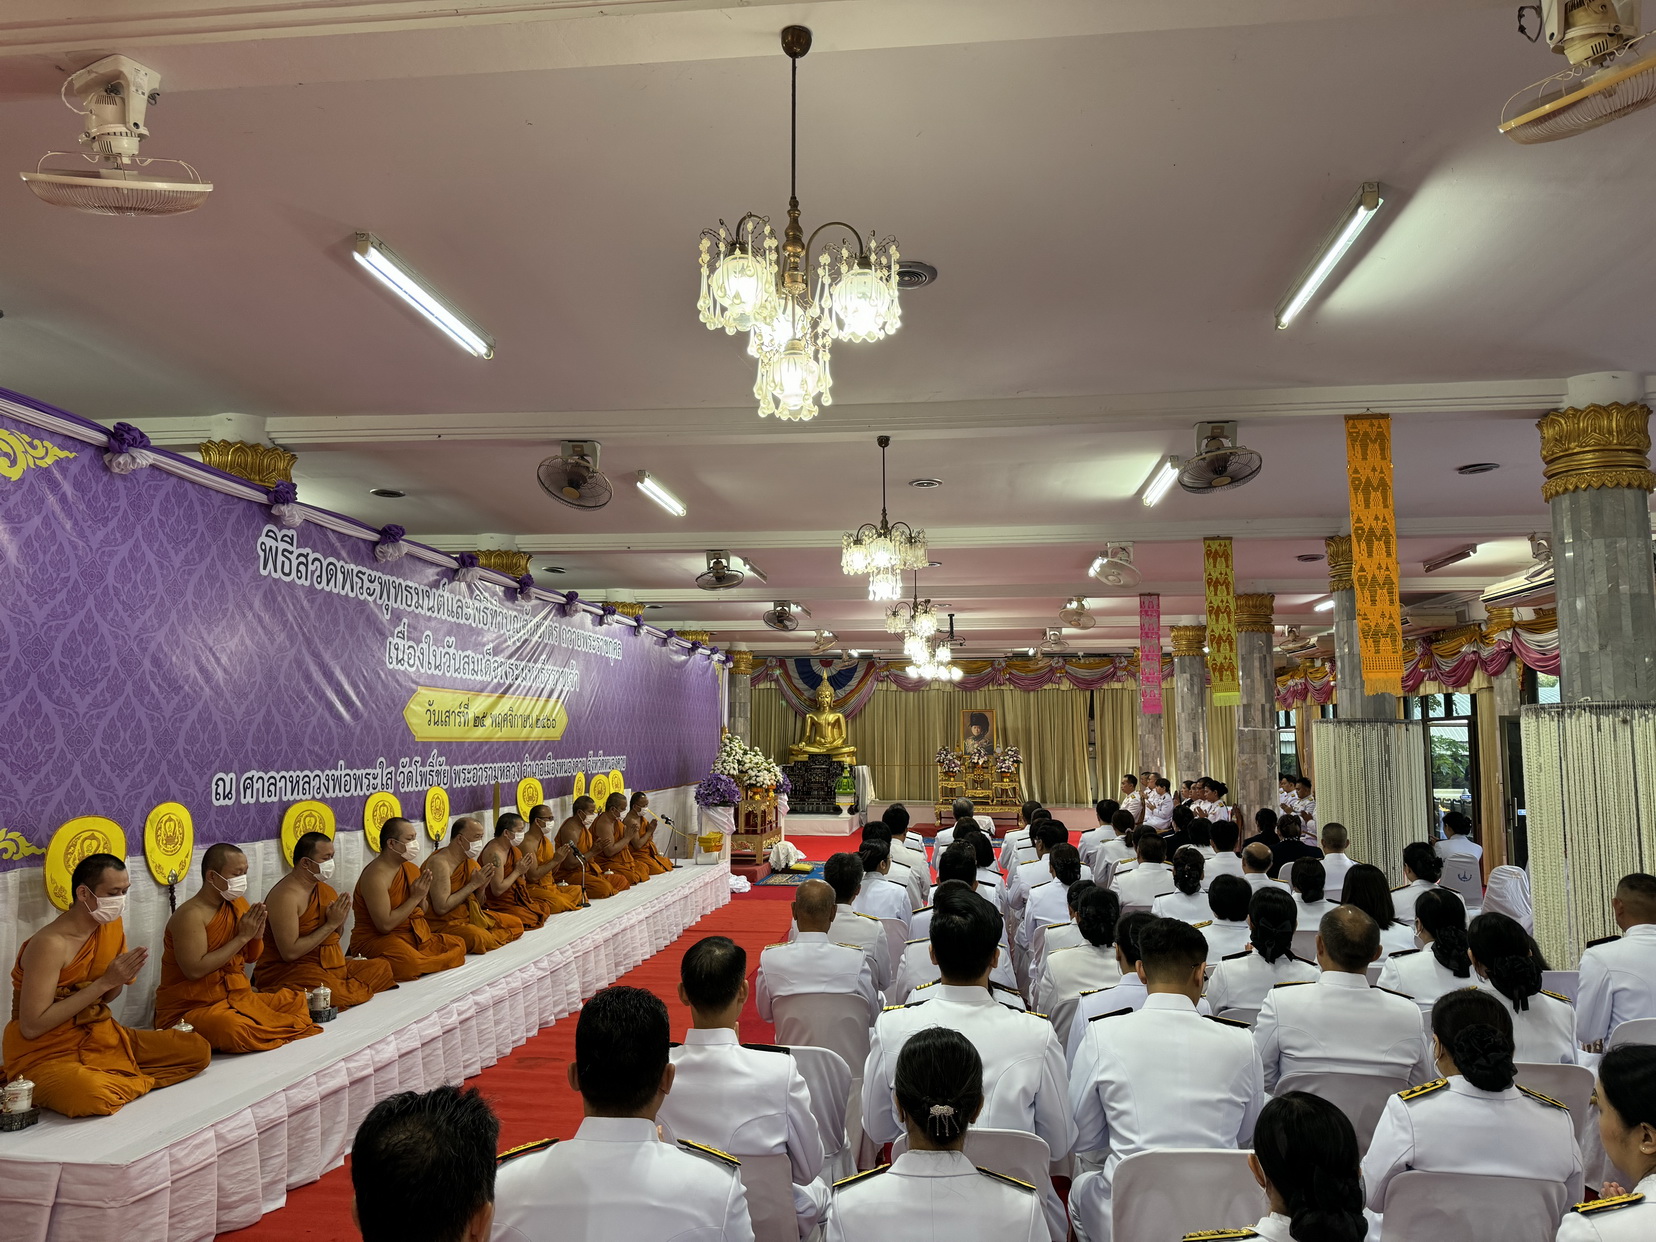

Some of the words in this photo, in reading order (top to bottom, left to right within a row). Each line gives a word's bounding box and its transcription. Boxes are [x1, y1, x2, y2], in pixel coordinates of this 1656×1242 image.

[425, 698, 470, 728] วันเสาร์ที่
[473, 711, 488, 729] ๒๕
[490, 706, 534, 733] พฤศจิกายน
[214, 775, 234, 802] ณ
[242, 760, 394, 800] ศาลาหลวงพ่อพระใส
[398, 751, 449, 791] วัดโพธิ์ชัย
[453, 762, 520, 787] พระอารามหลวง
